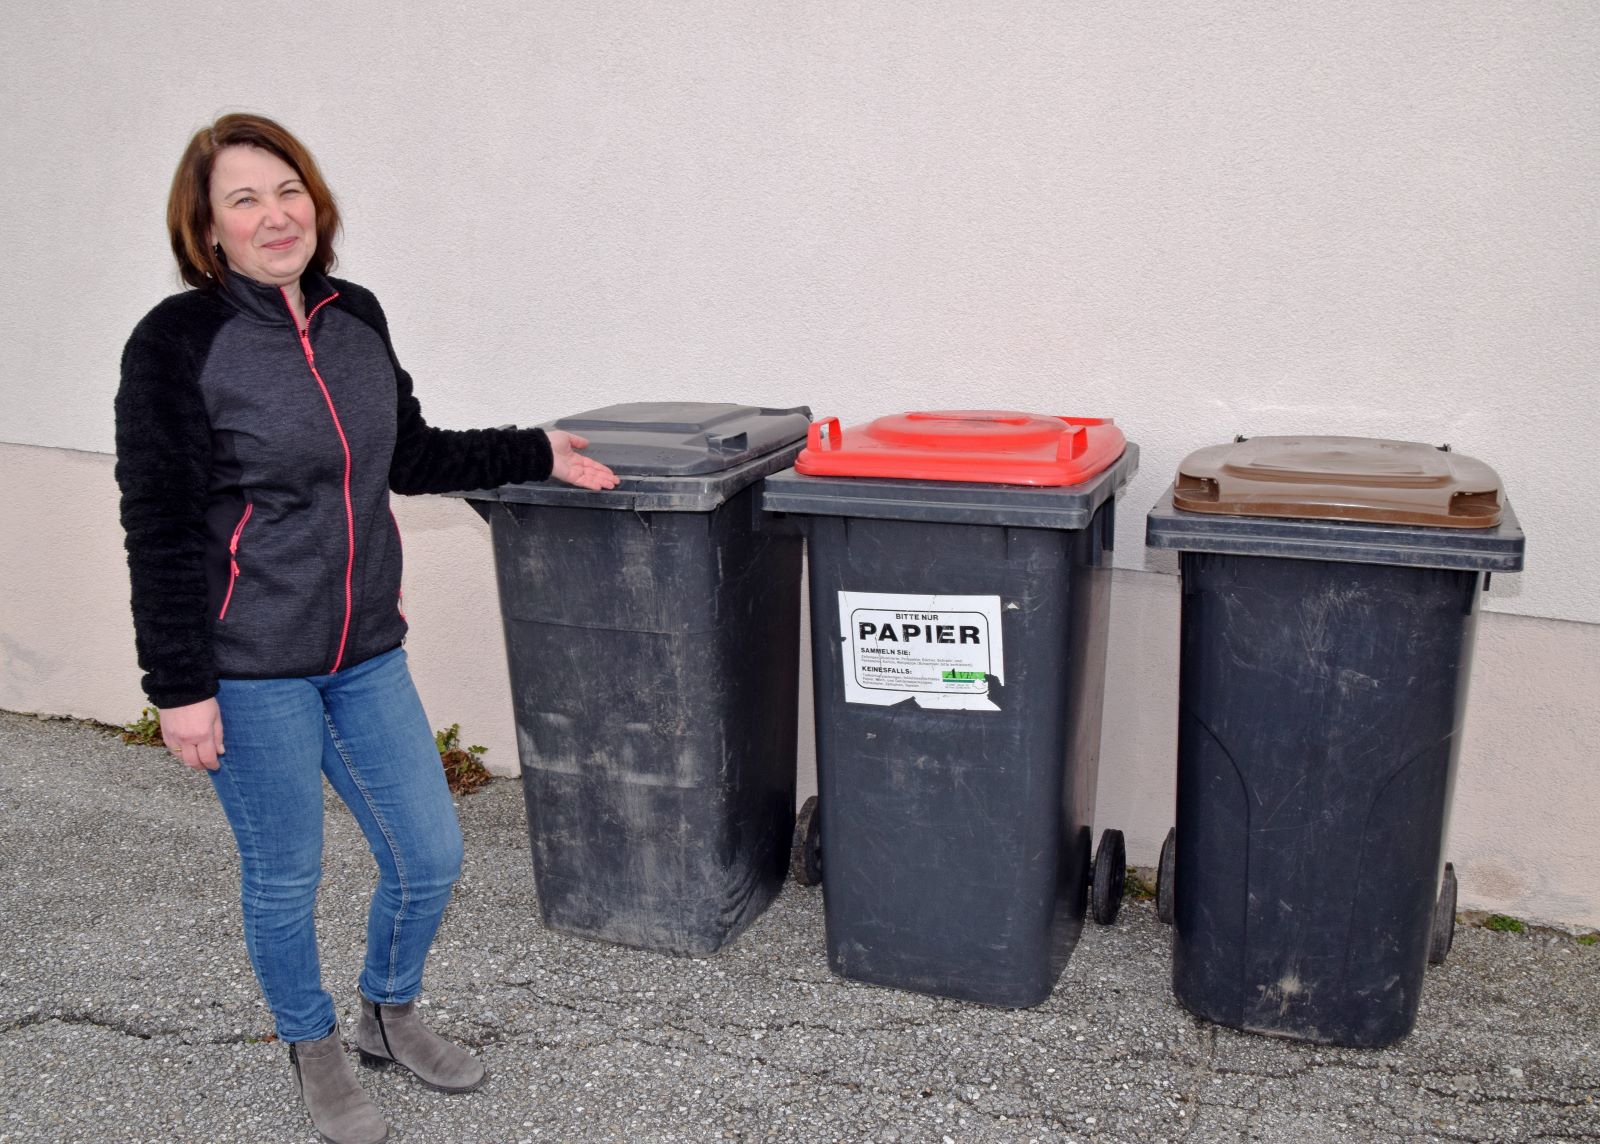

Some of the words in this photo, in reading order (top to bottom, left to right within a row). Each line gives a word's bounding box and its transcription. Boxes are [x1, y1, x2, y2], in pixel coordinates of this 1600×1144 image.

[859, 621, 980, 644] PAPIER
[861, 647, 895, 655] SAMMELN
[862, 666, 912, 675] KEINESFALLS:
